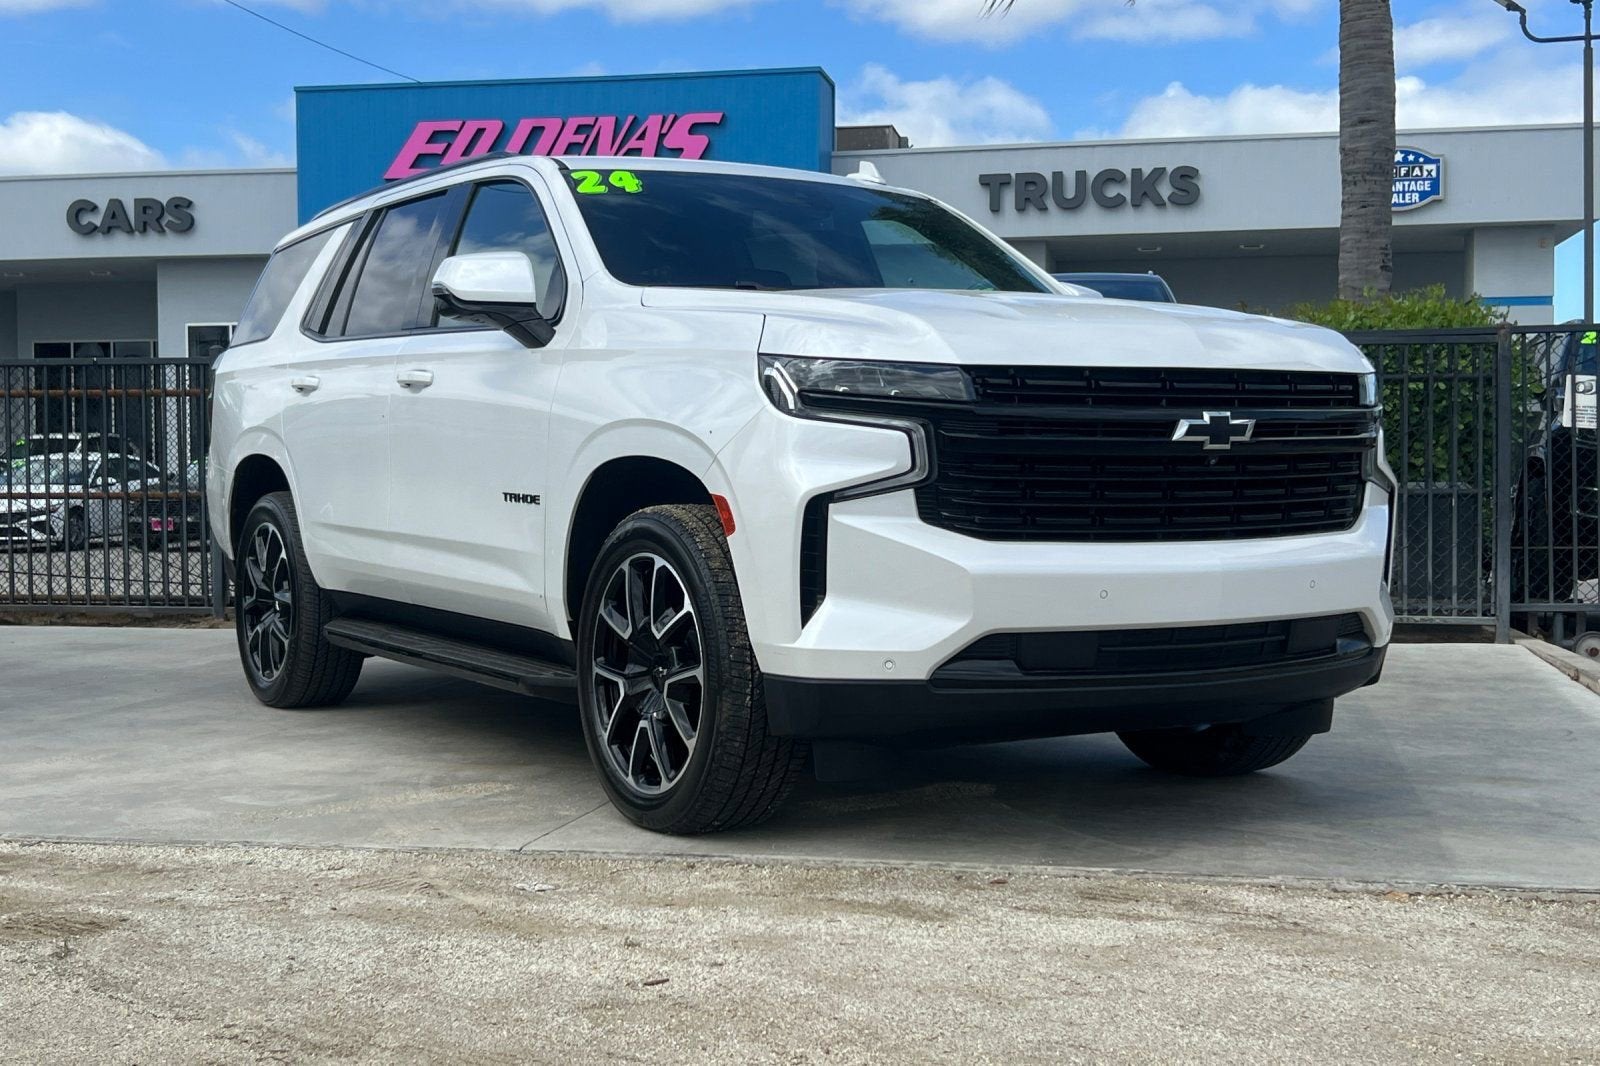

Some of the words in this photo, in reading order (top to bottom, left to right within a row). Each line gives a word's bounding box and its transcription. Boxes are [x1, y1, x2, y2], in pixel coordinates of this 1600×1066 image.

[383, 119, 505, 180] ED
[505, 112, 725, 160] DENA'S
[1393, 166, 1434, 177] FAX
[570, 170, 643, 194] 24
[979, 165, 1201, 212] TRUCKS
[1392, 180, 1431, 192] NTAGE
[1391, 192, 1420, 204] ALER
[66, 195, 195, 236] CARS
[502, 492, 541, 505] TAHOE
